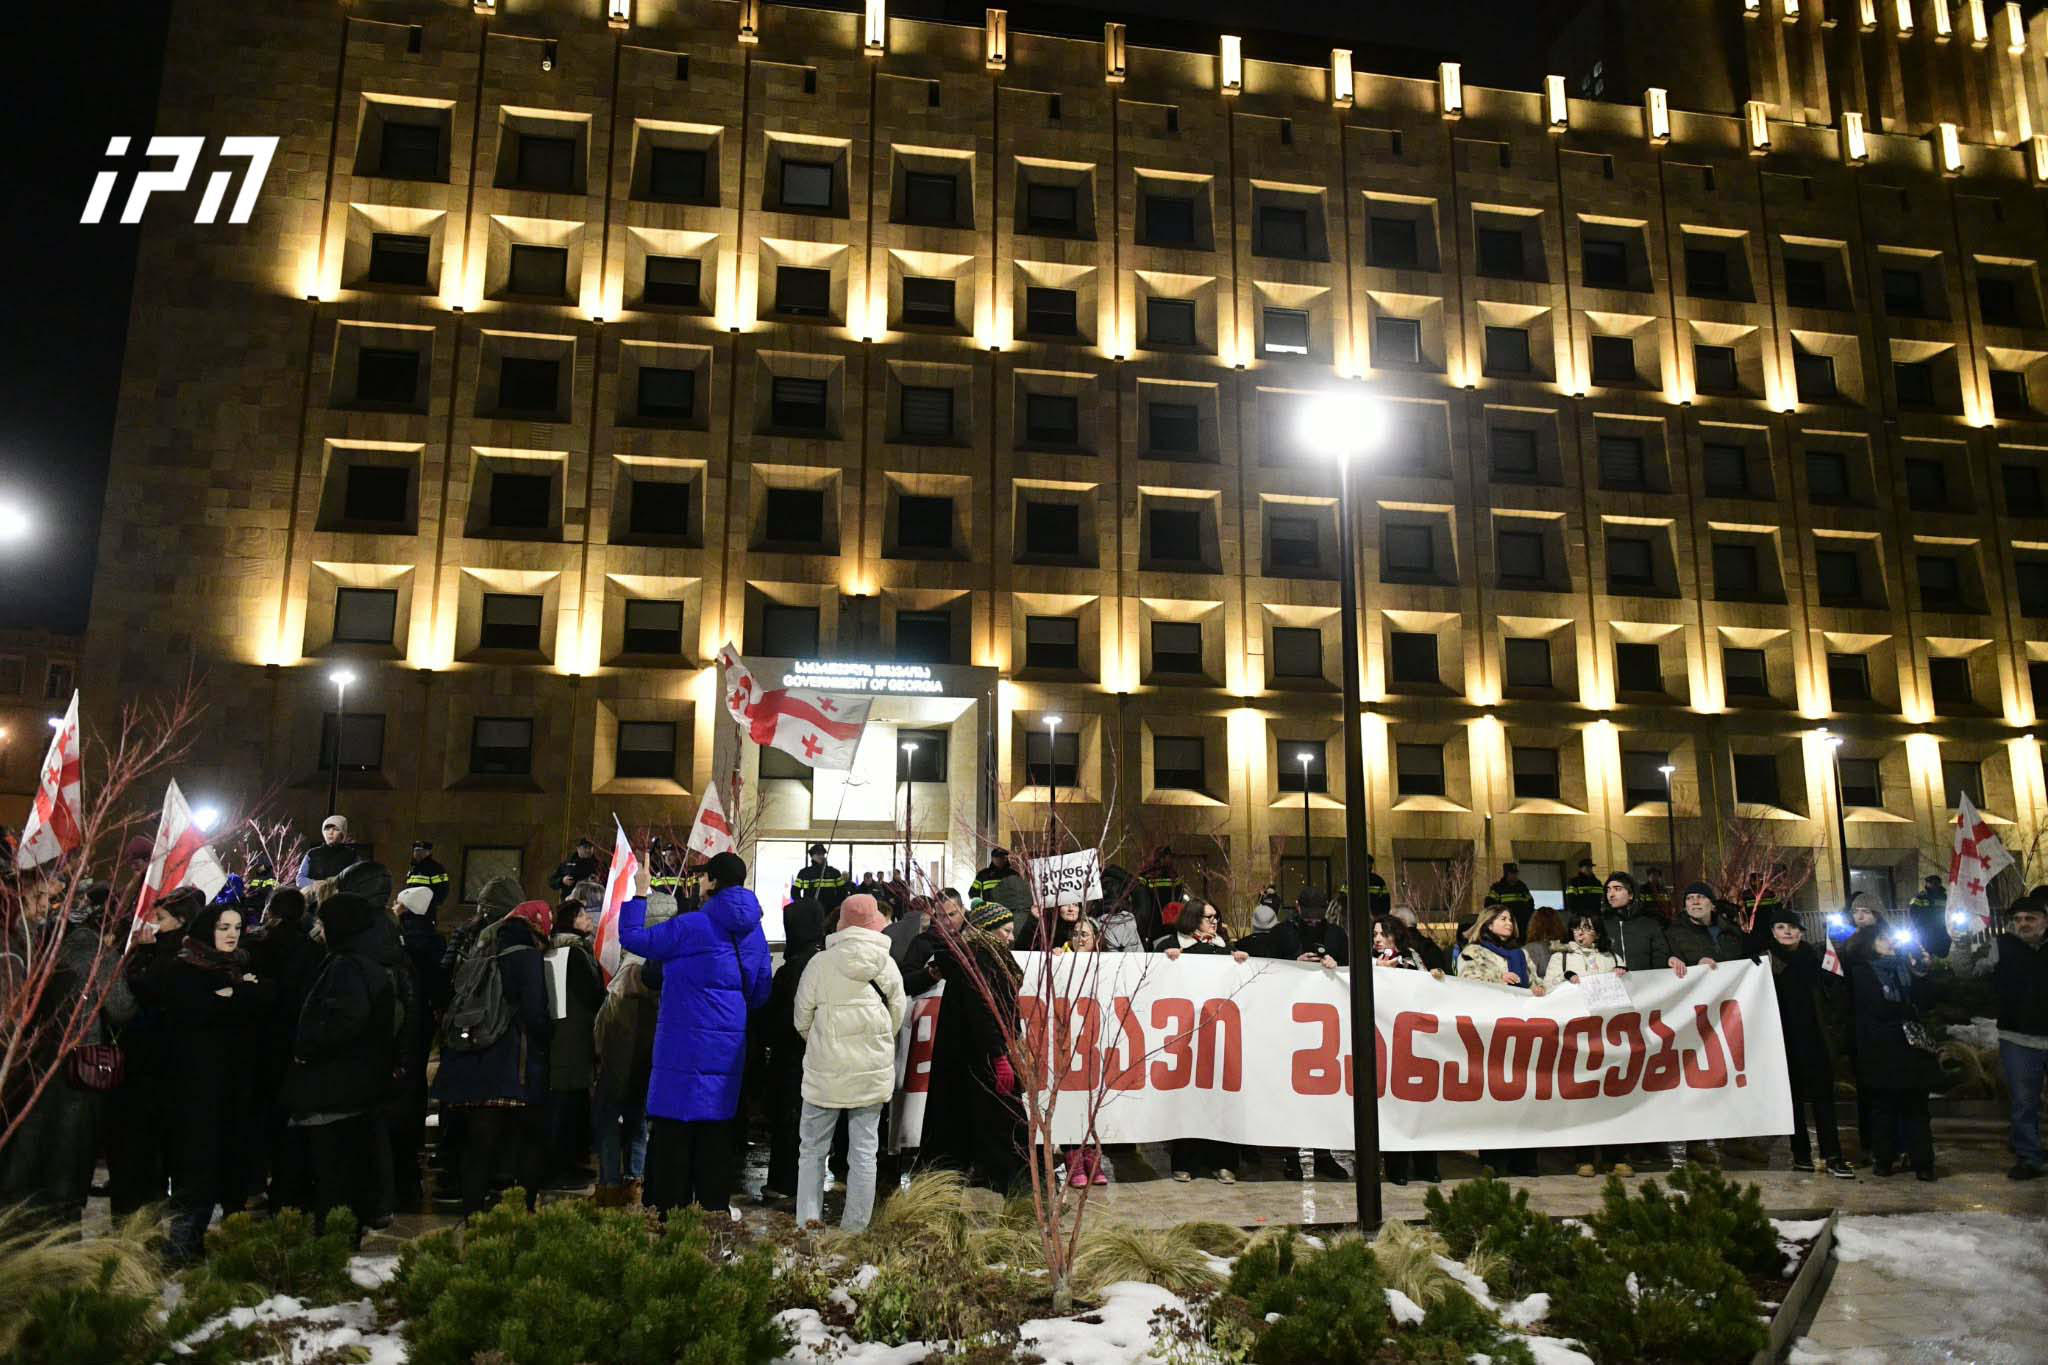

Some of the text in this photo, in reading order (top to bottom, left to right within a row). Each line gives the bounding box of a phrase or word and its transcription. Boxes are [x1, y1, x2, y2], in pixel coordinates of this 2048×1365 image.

[870, 678, 887, 691] OF
[888, 679, 944, 693] GEORGIA
[903, 996, 1242, 1094] დიცავი
